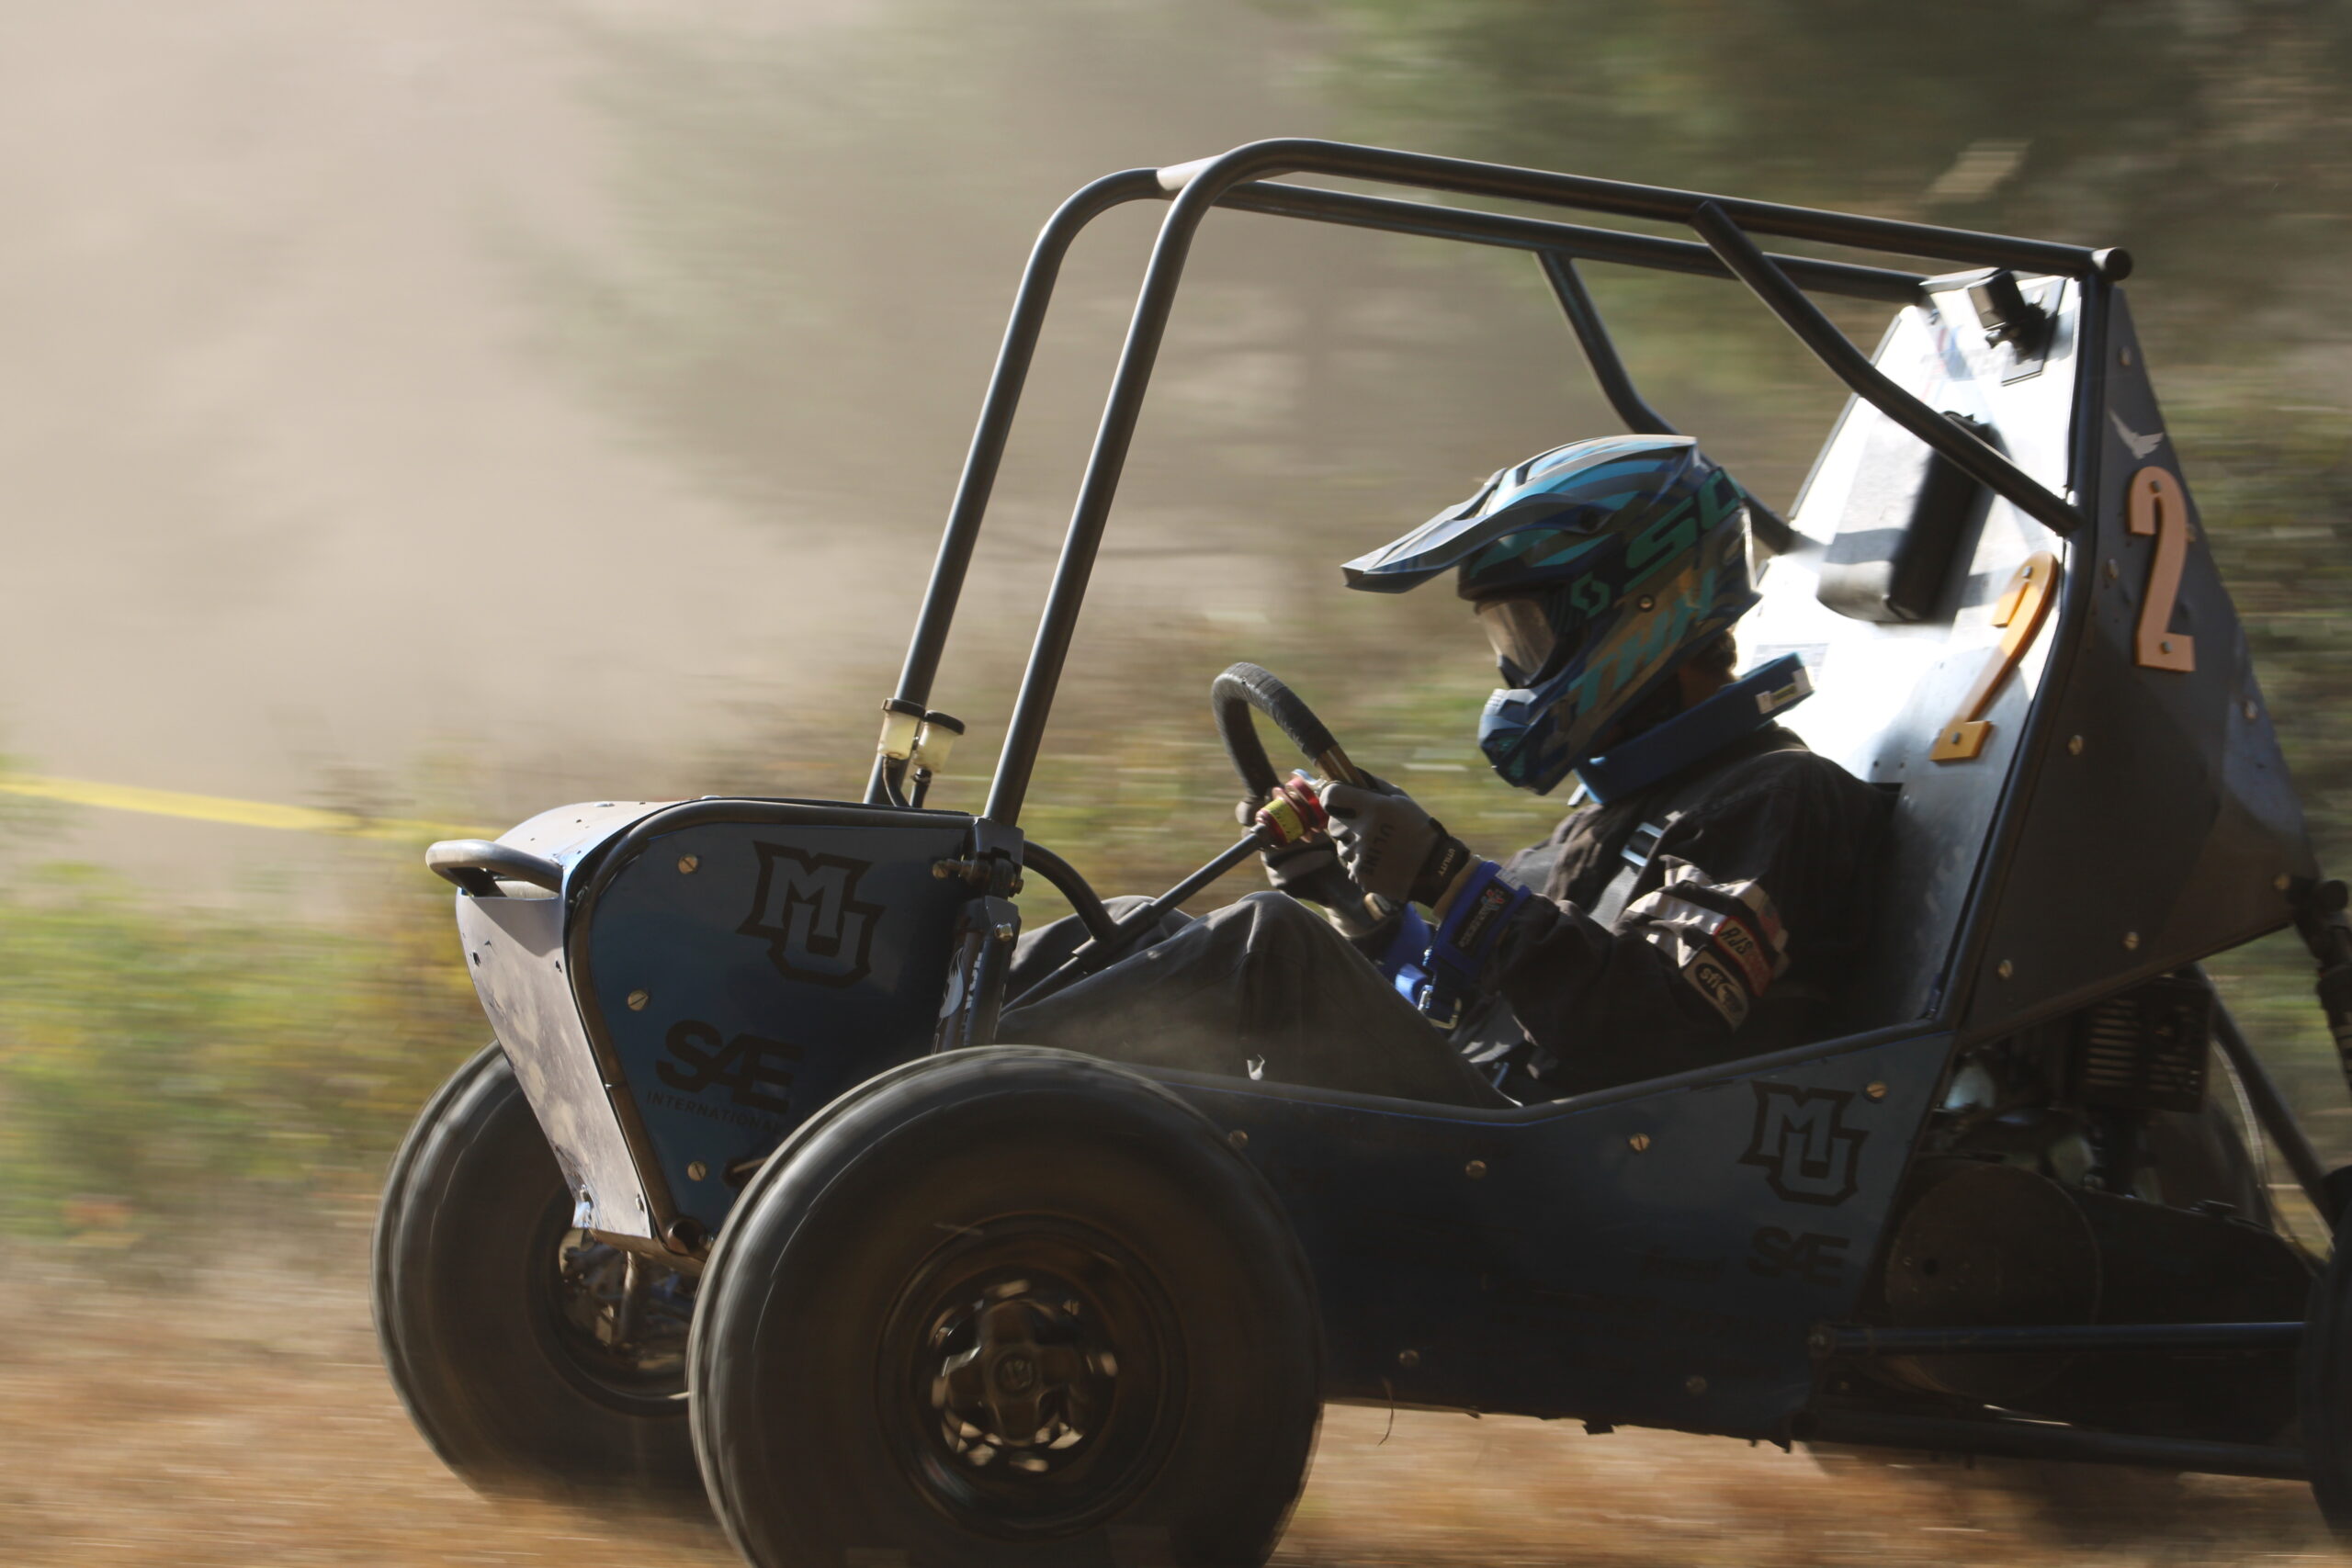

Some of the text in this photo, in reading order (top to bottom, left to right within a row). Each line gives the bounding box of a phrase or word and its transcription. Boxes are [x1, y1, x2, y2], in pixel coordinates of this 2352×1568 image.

[2127, 466, 2197, 672] 2
[1929, 551, 2060, 761] 2
[735, 840, 886, 987] MU
[1720, 928, 1754, 954] RJS
[646, 1090, 784, 1136] INTERNATIONAL
[656, 1020, 806, 1114] SAE
[1738, 1080, 1869, 1206] MU
[1746, 1225, 1850, 1288] SAE
